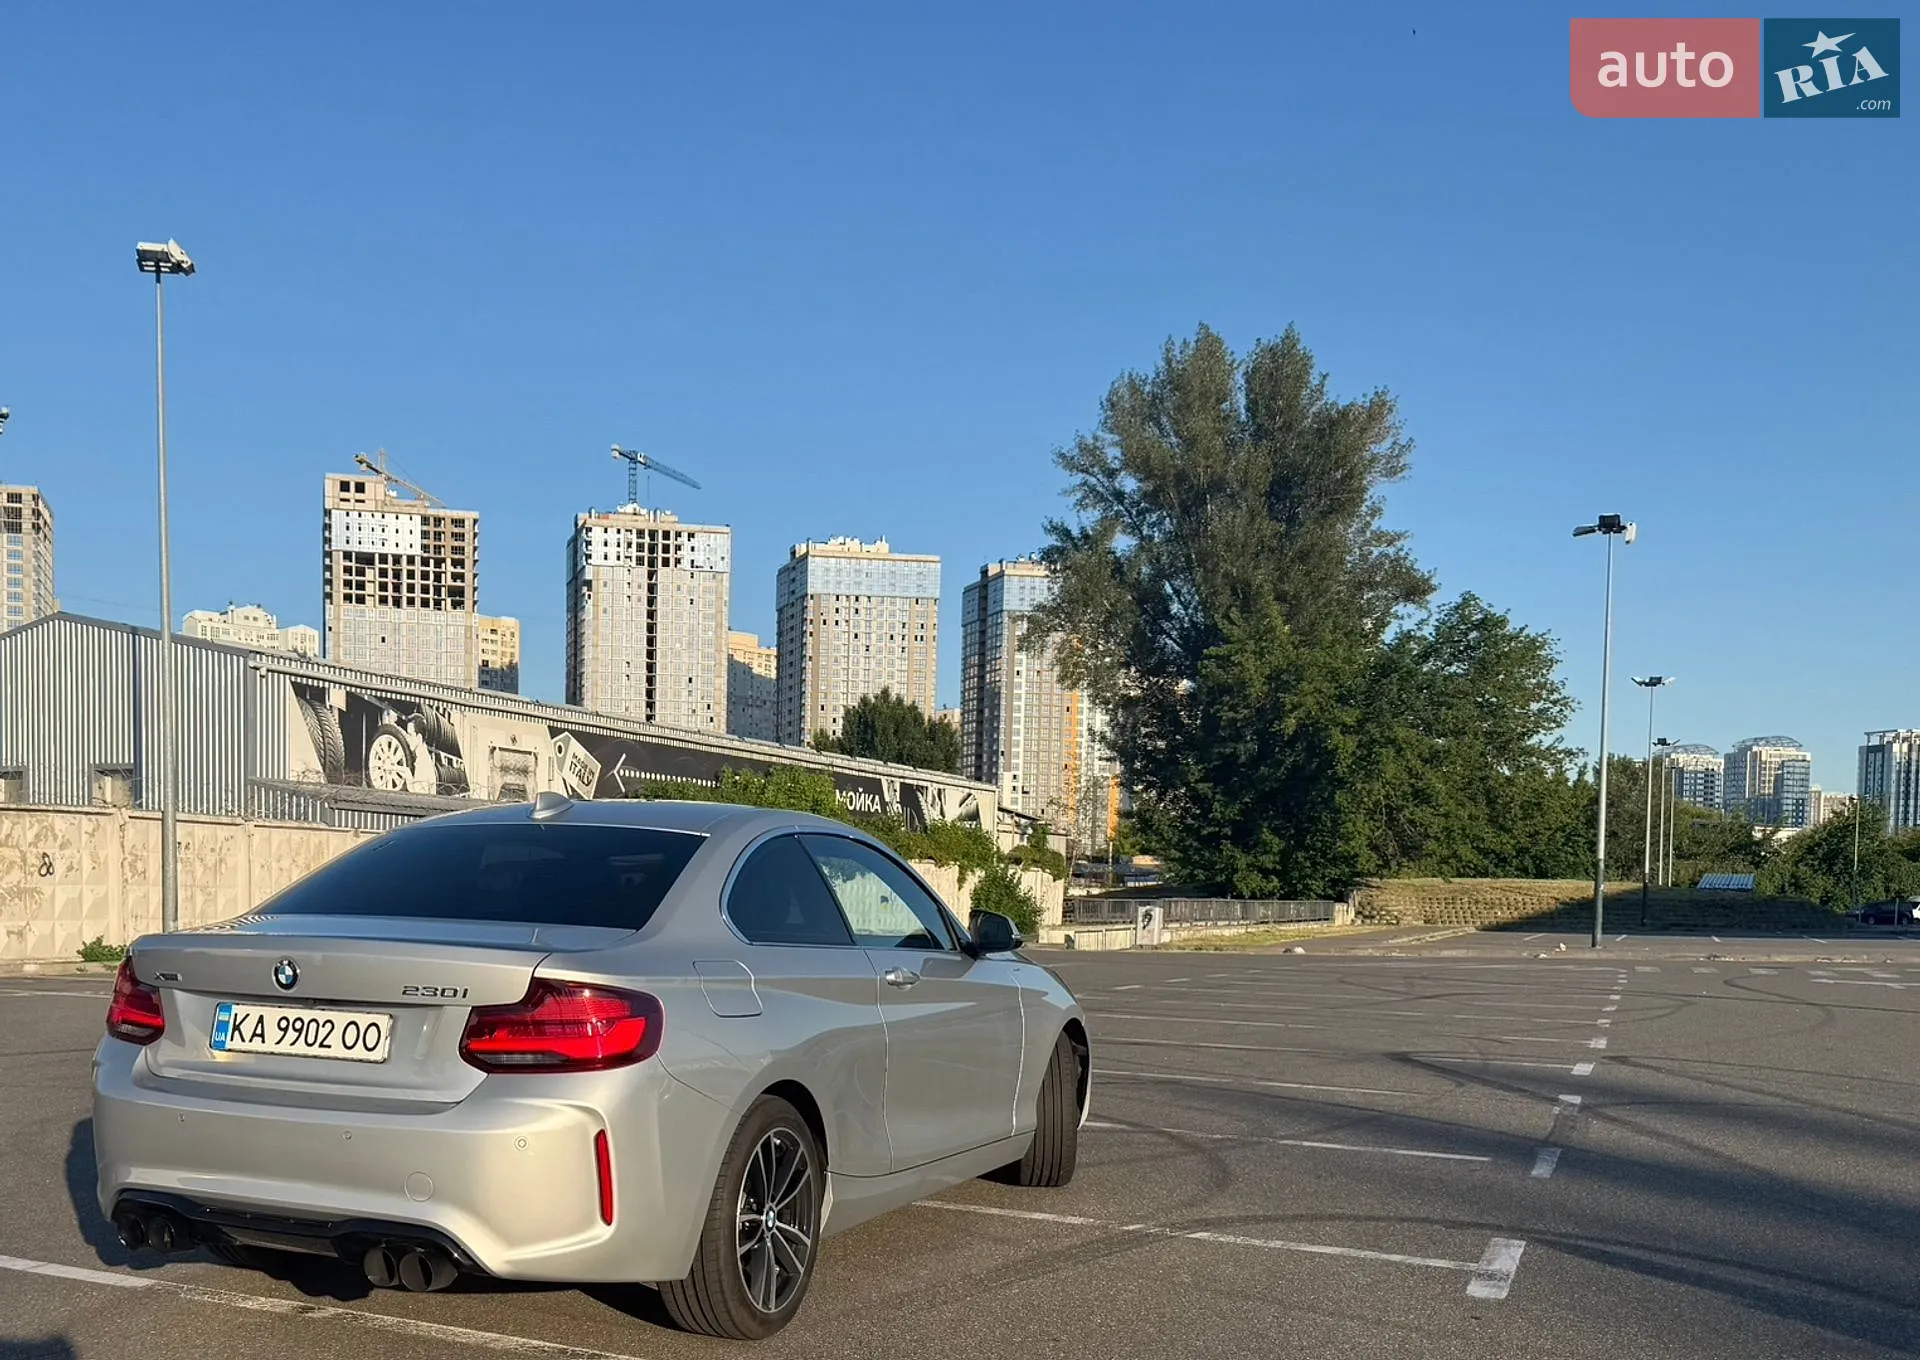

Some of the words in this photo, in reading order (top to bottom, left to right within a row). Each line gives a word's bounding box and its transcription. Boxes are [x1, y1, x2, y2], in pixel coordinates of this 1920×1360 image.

[569, 760, 593, 787] ITALY
[835, 787, 882, 814] МОЙКА
[214, 1031, 226, 1042] UA
[230, 1013, 266, 1044] KA
[274, 1016, 335, 1049] 9902
